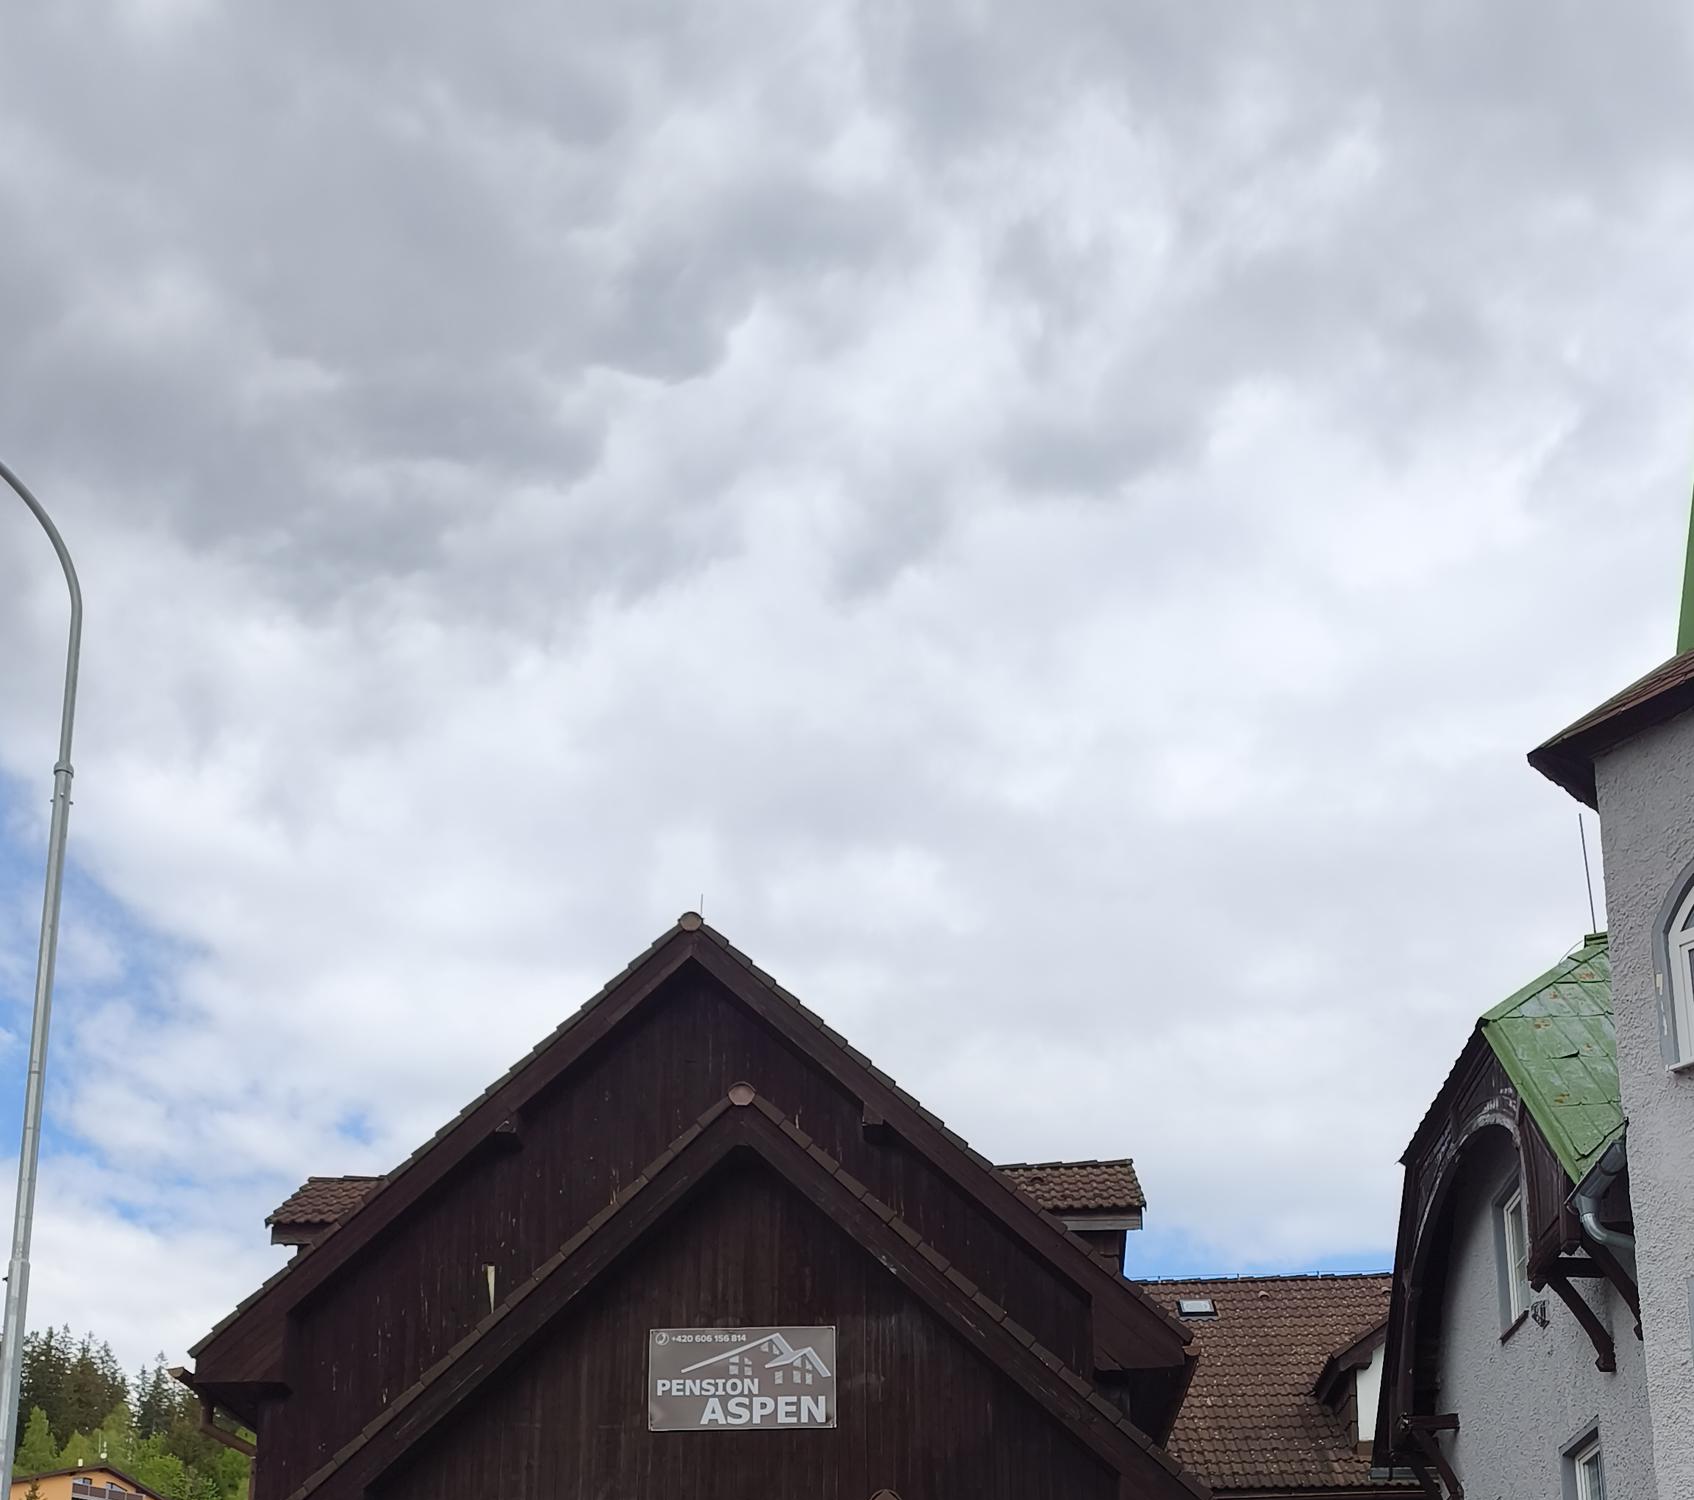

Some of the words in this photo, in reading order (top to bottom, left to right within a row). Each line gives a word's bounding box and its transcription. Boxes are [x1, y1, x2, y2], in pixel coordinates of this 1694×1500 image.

[671, 1334, 693, 1343] +420
[695, 1334, 712, 1343] 606
[714, 1334, 730, 1343] 156
[731, 1334, 747, 1342] 814
[656, 1378, 759, 1396] PENSION
[700, 1395, 826, 1425] ASPEN
